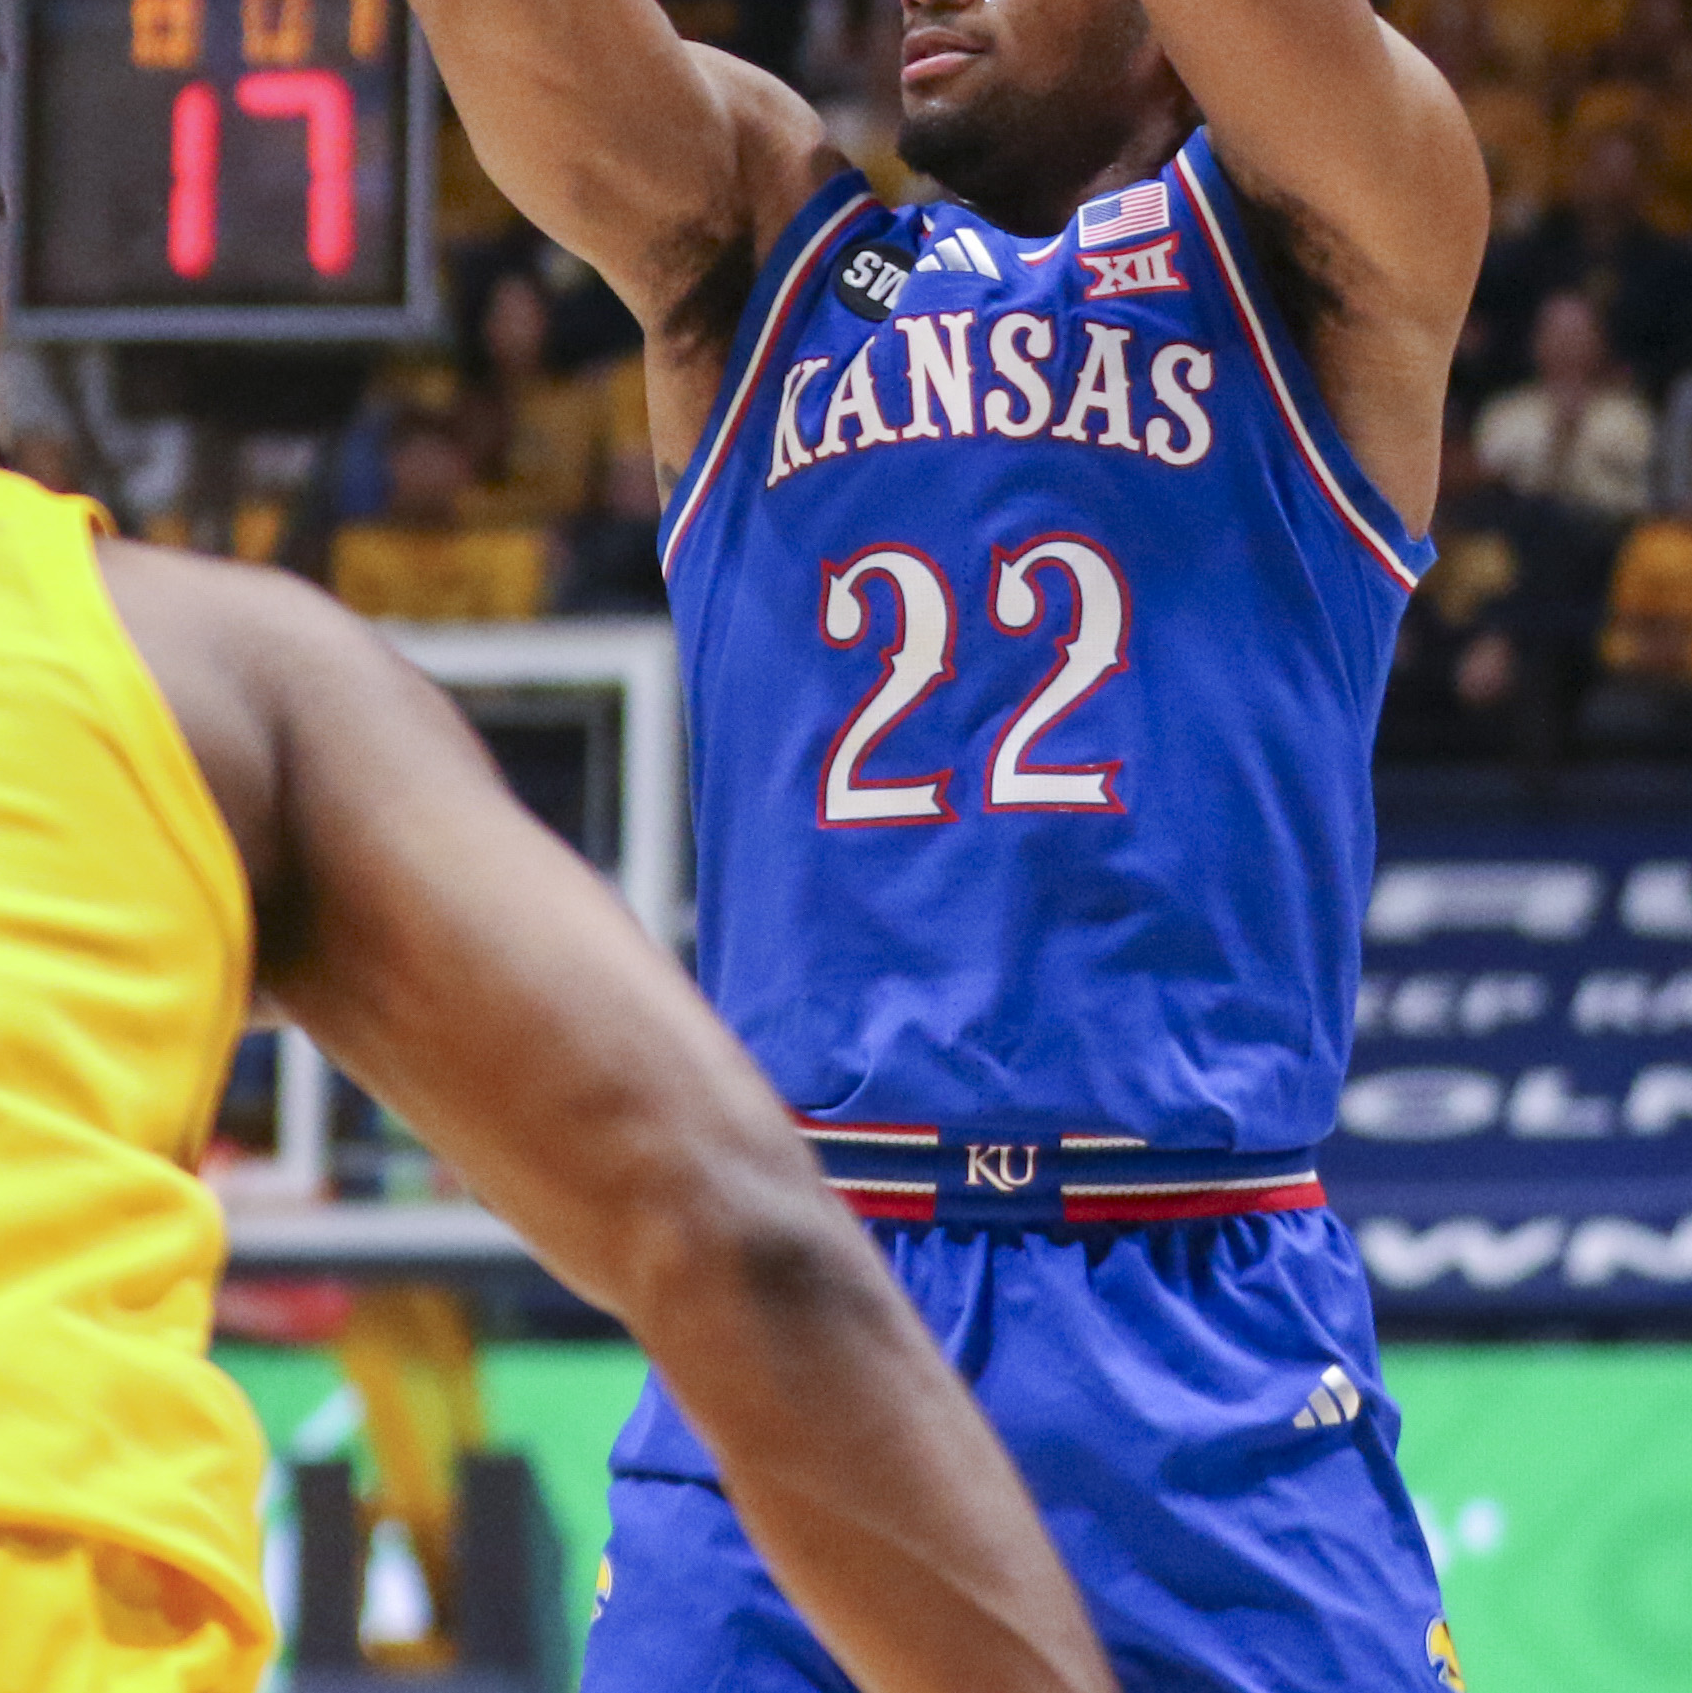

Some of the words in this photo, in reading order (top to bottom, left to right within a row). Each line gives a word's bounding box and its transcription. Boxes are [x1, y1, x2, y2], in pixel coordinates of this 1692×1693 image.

[166, 69, 357, 279] 17
[1078, 237, 1184, 299] XII
[766, 311, 1213, 488] KANSAS
[817, 531, 1128, 829] 22
[964, 1144, 1039, 1192] KU
